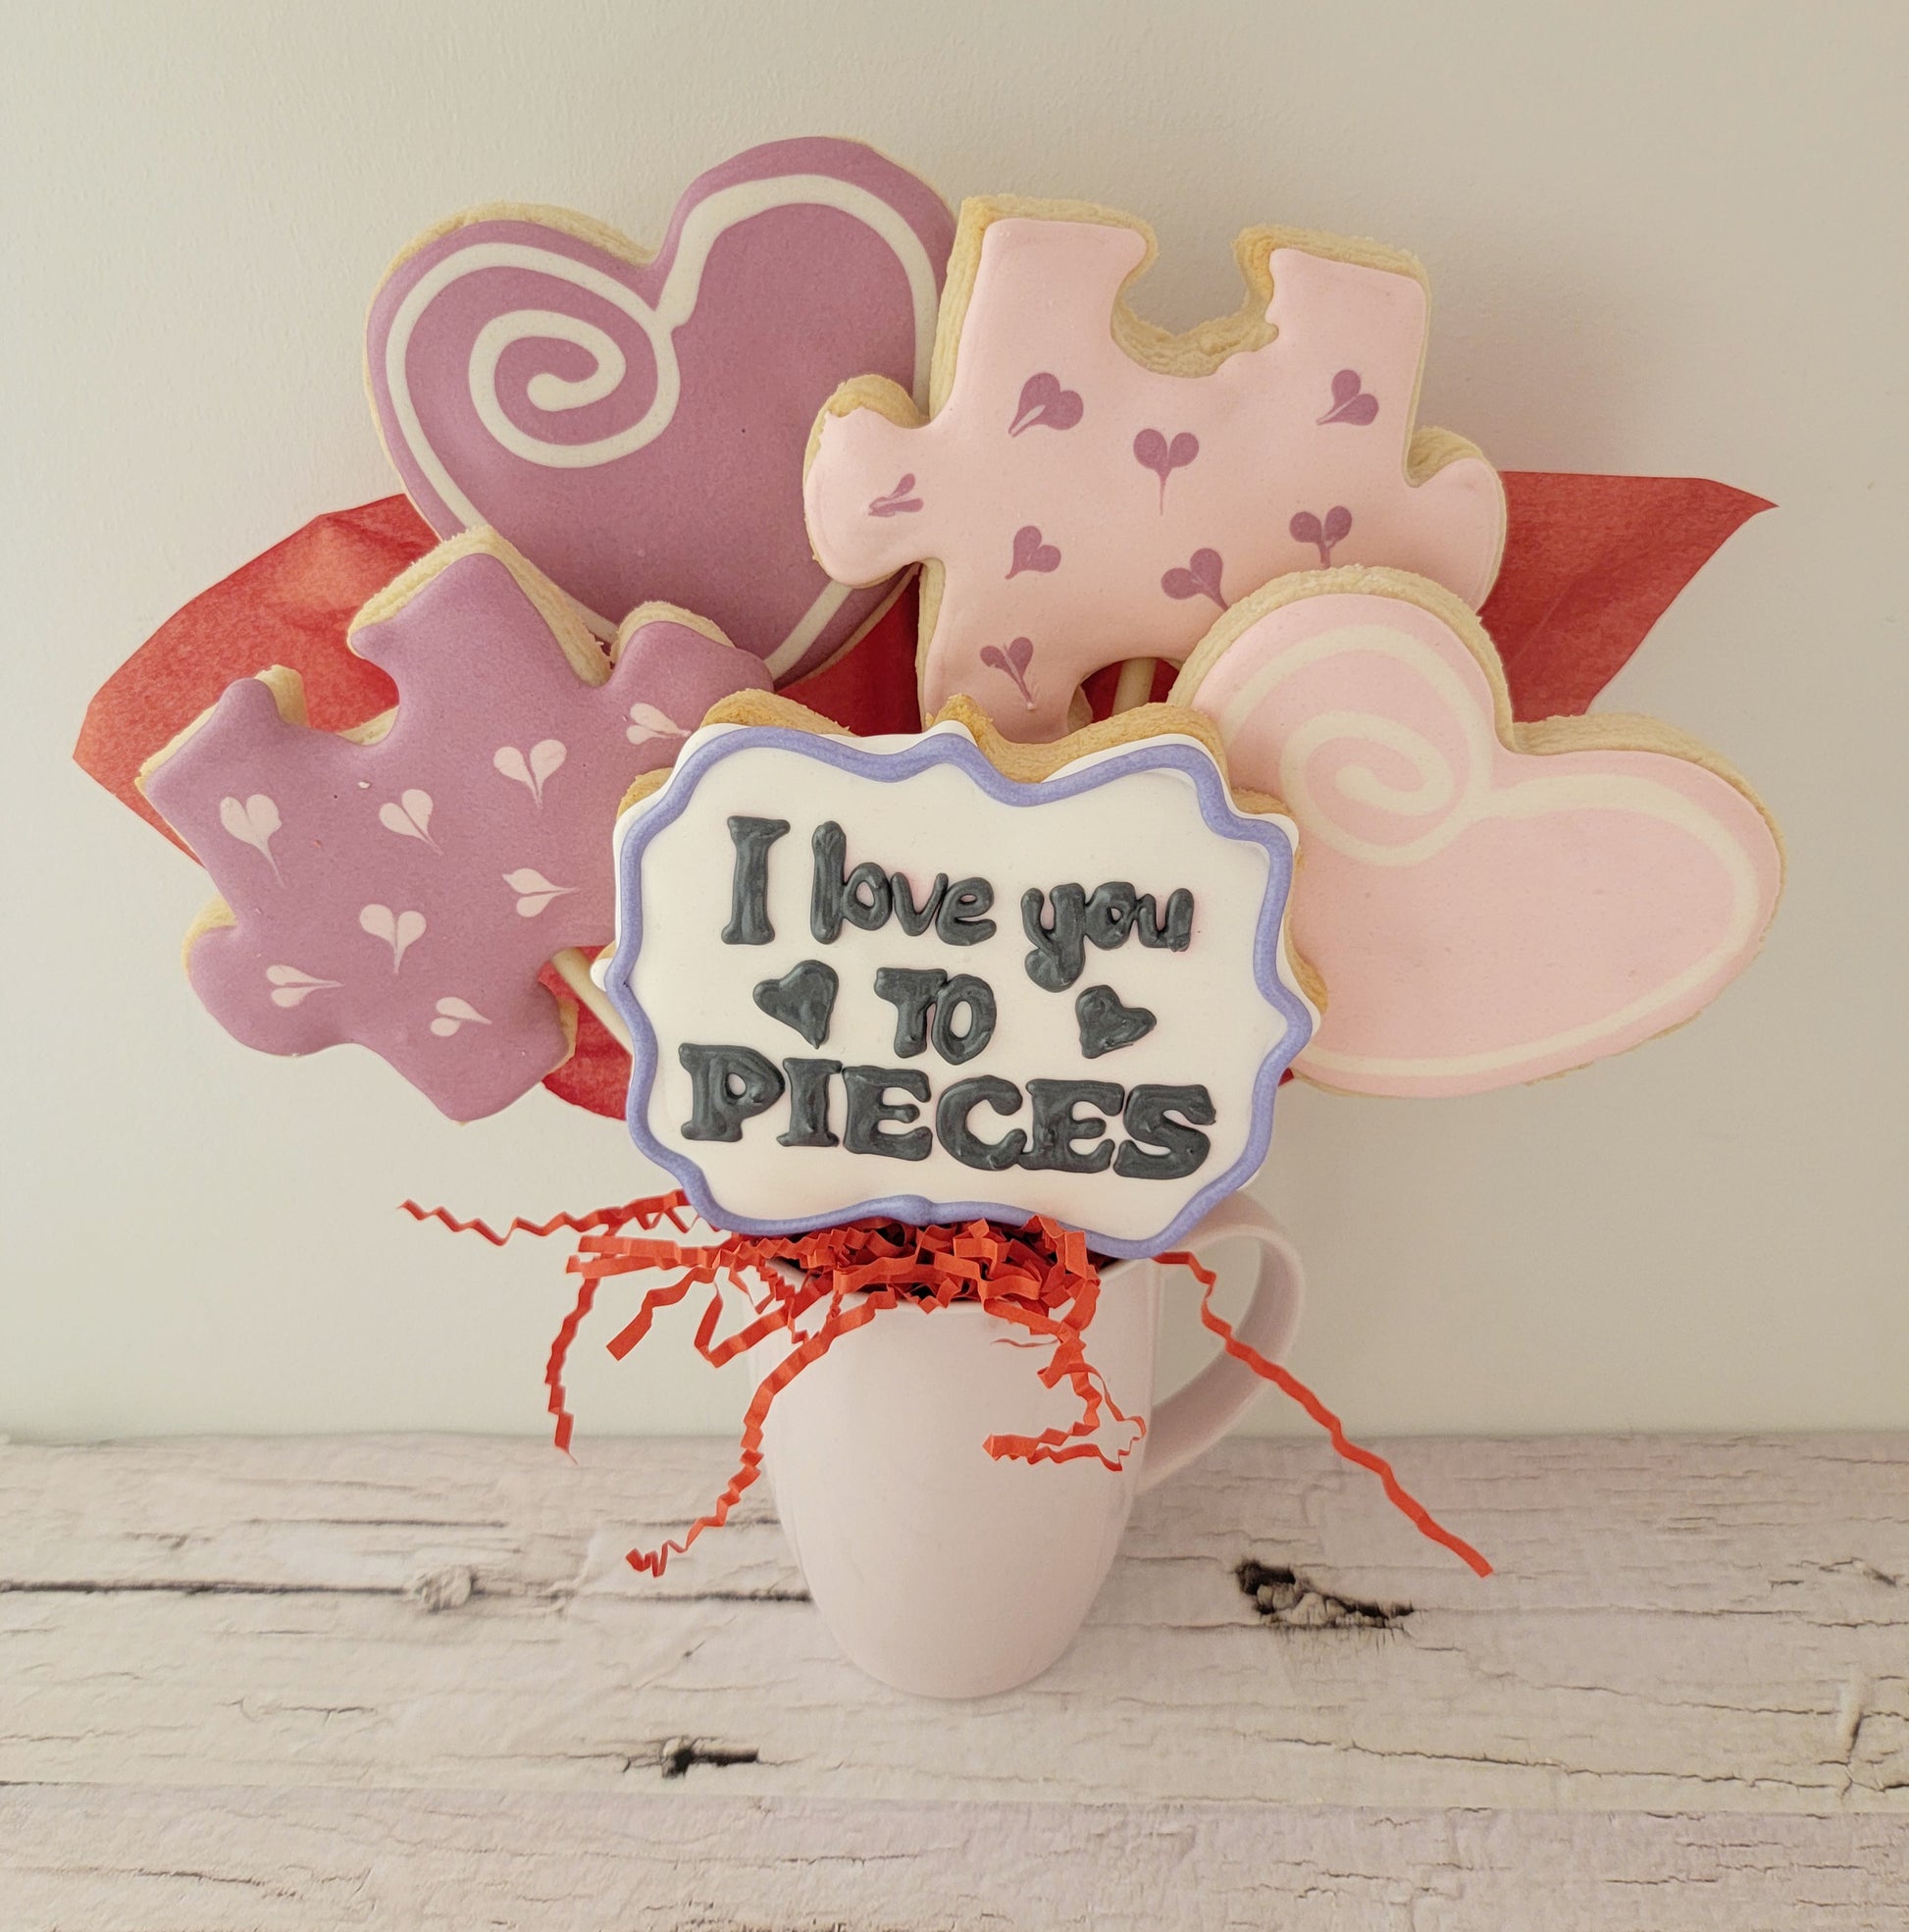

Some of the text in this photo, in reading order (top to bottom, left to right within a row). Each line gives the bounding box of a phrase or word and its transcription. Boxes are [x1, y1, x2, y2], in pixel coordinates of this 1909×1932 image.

[722, 815, 1195, 994] I love you
[873, 966, 997, 1067] TO
[678, 1042, 1217, 1180] PIECES
